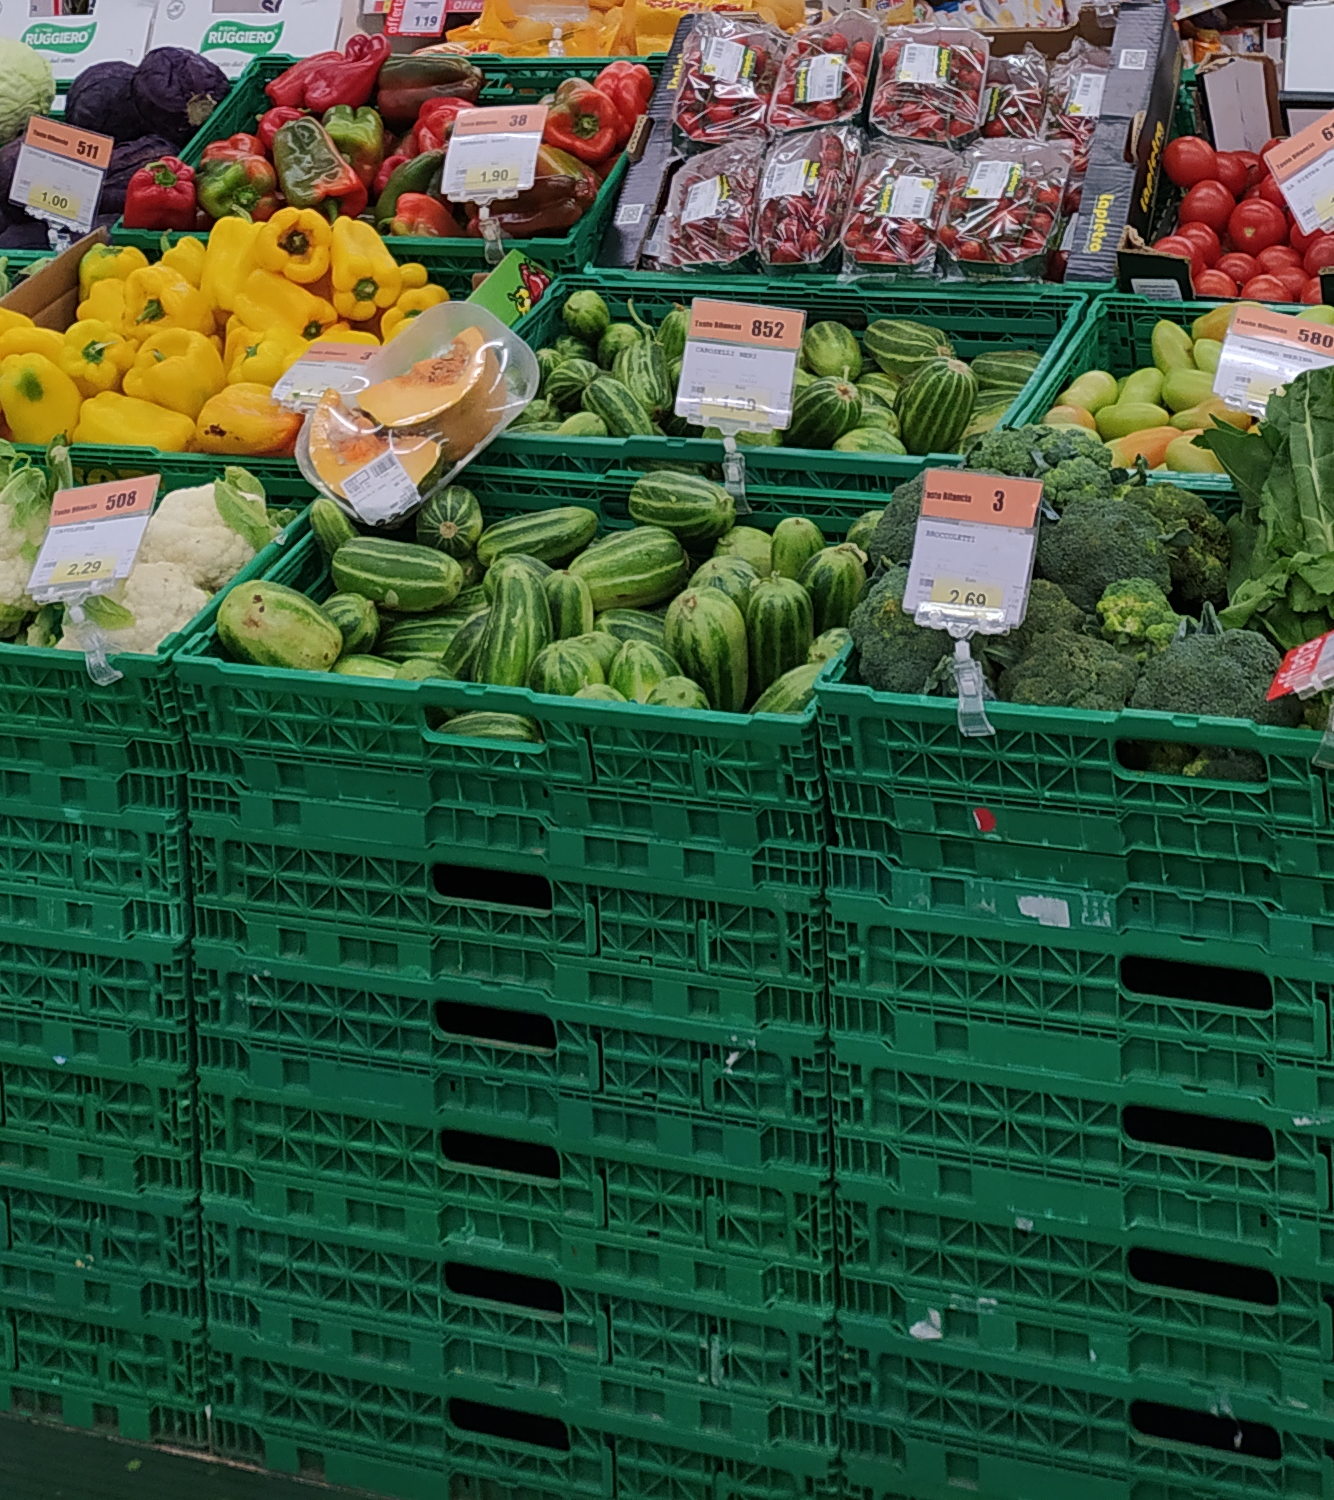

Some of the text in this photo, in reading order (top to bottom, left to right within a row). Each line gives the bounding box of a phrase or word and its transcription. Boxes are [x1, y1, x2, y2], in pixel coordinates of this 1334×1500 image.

[451, 0, 484, 11] Offer
[24, 29, 90, 47] RUGGIERO
[207, 29, 277, 46] RUGGIERO
[508, 113, 529, 128] 38
[75, 139, 100, 160] 511
[479, 168, 510, 184] 1,90
[1089, 193, 1115, 253] lapietra
[750, 319, 786, 340] 852
[1297, 328, 1334, 349] 580
[104, 490, 138, 512] 508
[992, 489, 1006, 513] 3
[925, 529, 976, 544] BROCCOLETTI
[66, 560, 103, 577] 2,29
[948, 589, 987, 607] 269
